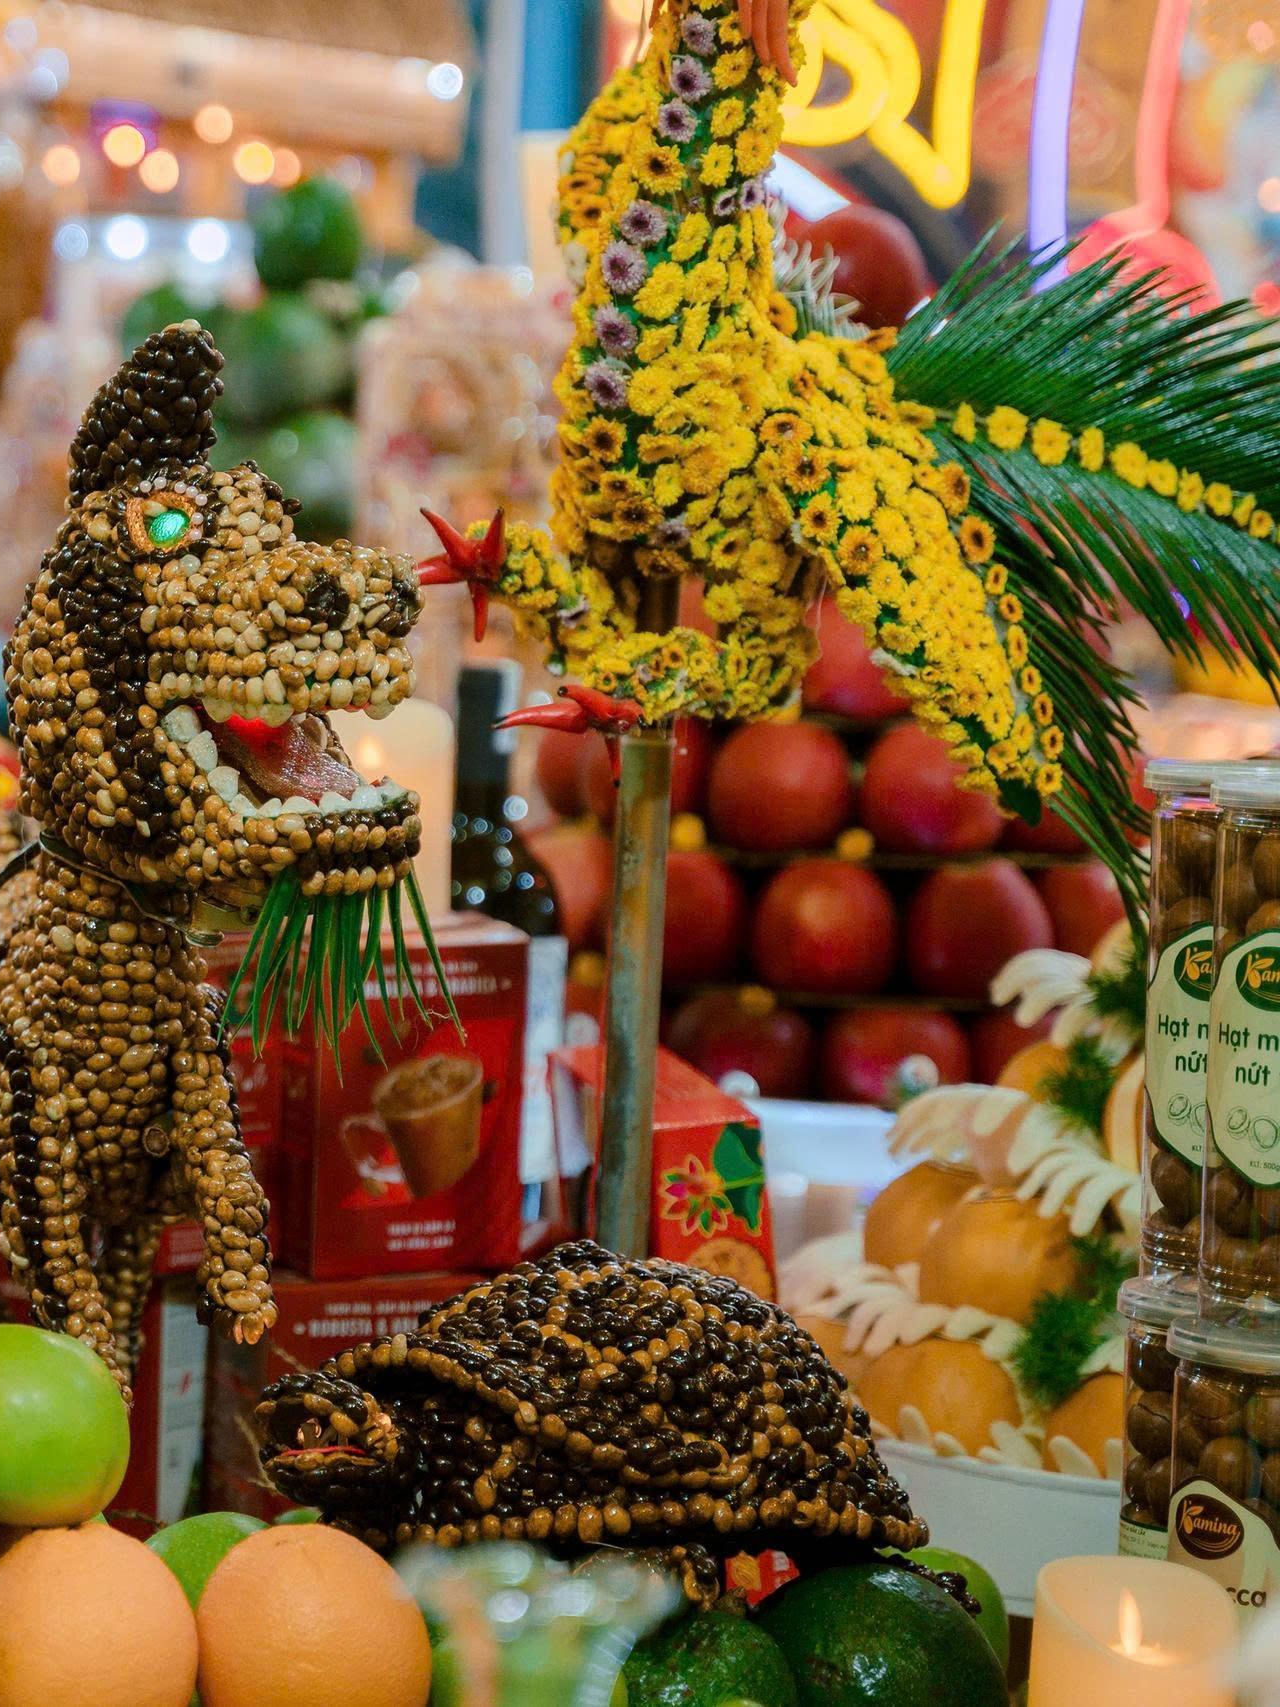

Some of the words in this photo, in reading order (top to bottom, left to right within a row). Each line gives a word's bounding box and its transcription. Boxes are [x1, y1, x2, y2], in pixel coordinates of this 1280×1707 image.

[1158, 1013, 1189, 1042] Hạt
[1219, 1022, 1250, 1052] Hạt
[1236, 1062, 1271, 1086] nứt
[1179, 1499, 1241, 1536] Kamina
